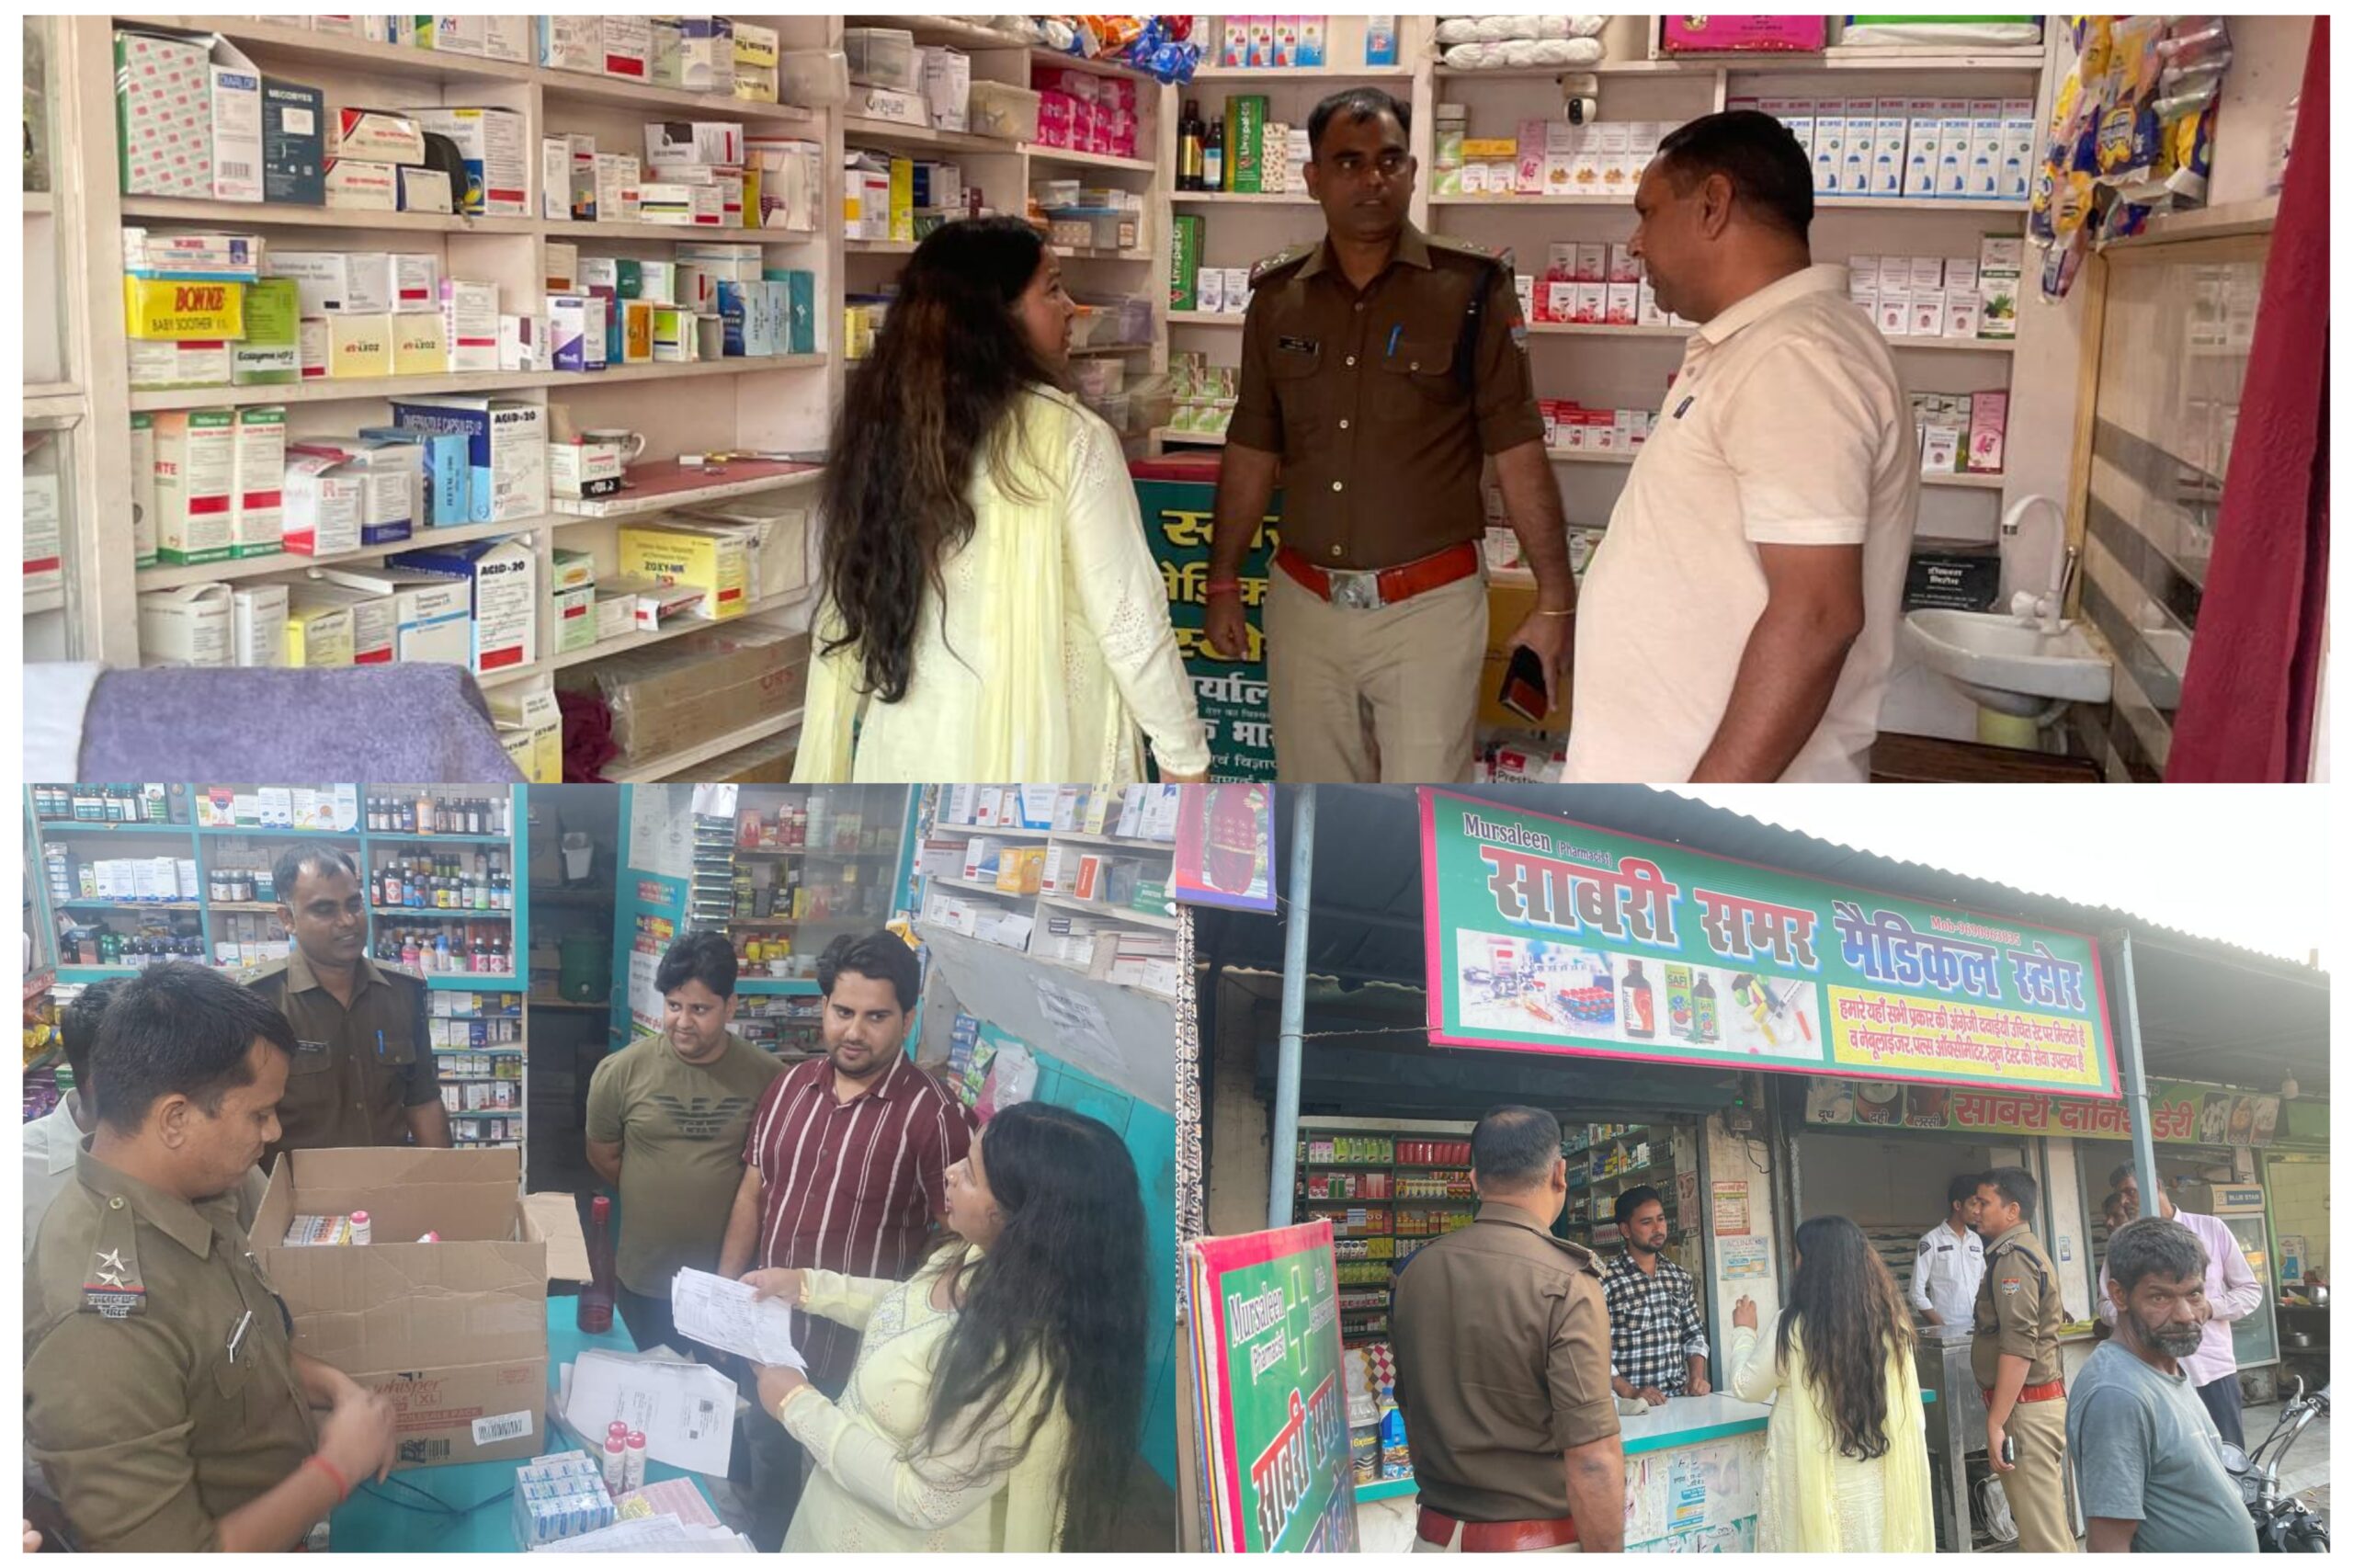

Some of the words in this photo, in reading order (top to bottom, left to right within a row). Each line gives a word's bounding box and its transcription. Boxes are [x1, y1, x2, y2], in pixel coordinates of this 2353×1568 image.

[494, 410, 537, 424] ACID-20
[480, 562, 526, 576] ACID-20
[1462, 812, 1552, 854] Mursaleen
[1556, 840, 1613, 868] (Pharmacist)
[1480, 845, 1680, 947] साबरी
[1693, 887, 1821, 970] समर
[1832, 900, 2001, 998] मैडिकल
[2006, 940, 2086, 1011] स्टोर
[1839, 995, 1866, 1019] हमारे
[1867, 997, 1886, 1023] यहाँ
[1886, 999, 1907, 1025] सभी
[1909, 1007, 1935, 1029] प्रकार
[1935, 1006, 1949, 1029] की
[1953, 1092, 2052, 1131] साबरी
[2153, 1099, 2197, 1141] डेरी
[1228, 1281, 1285, 1348] Mursaleen
[374, 1379, 441, 1396] whisper
